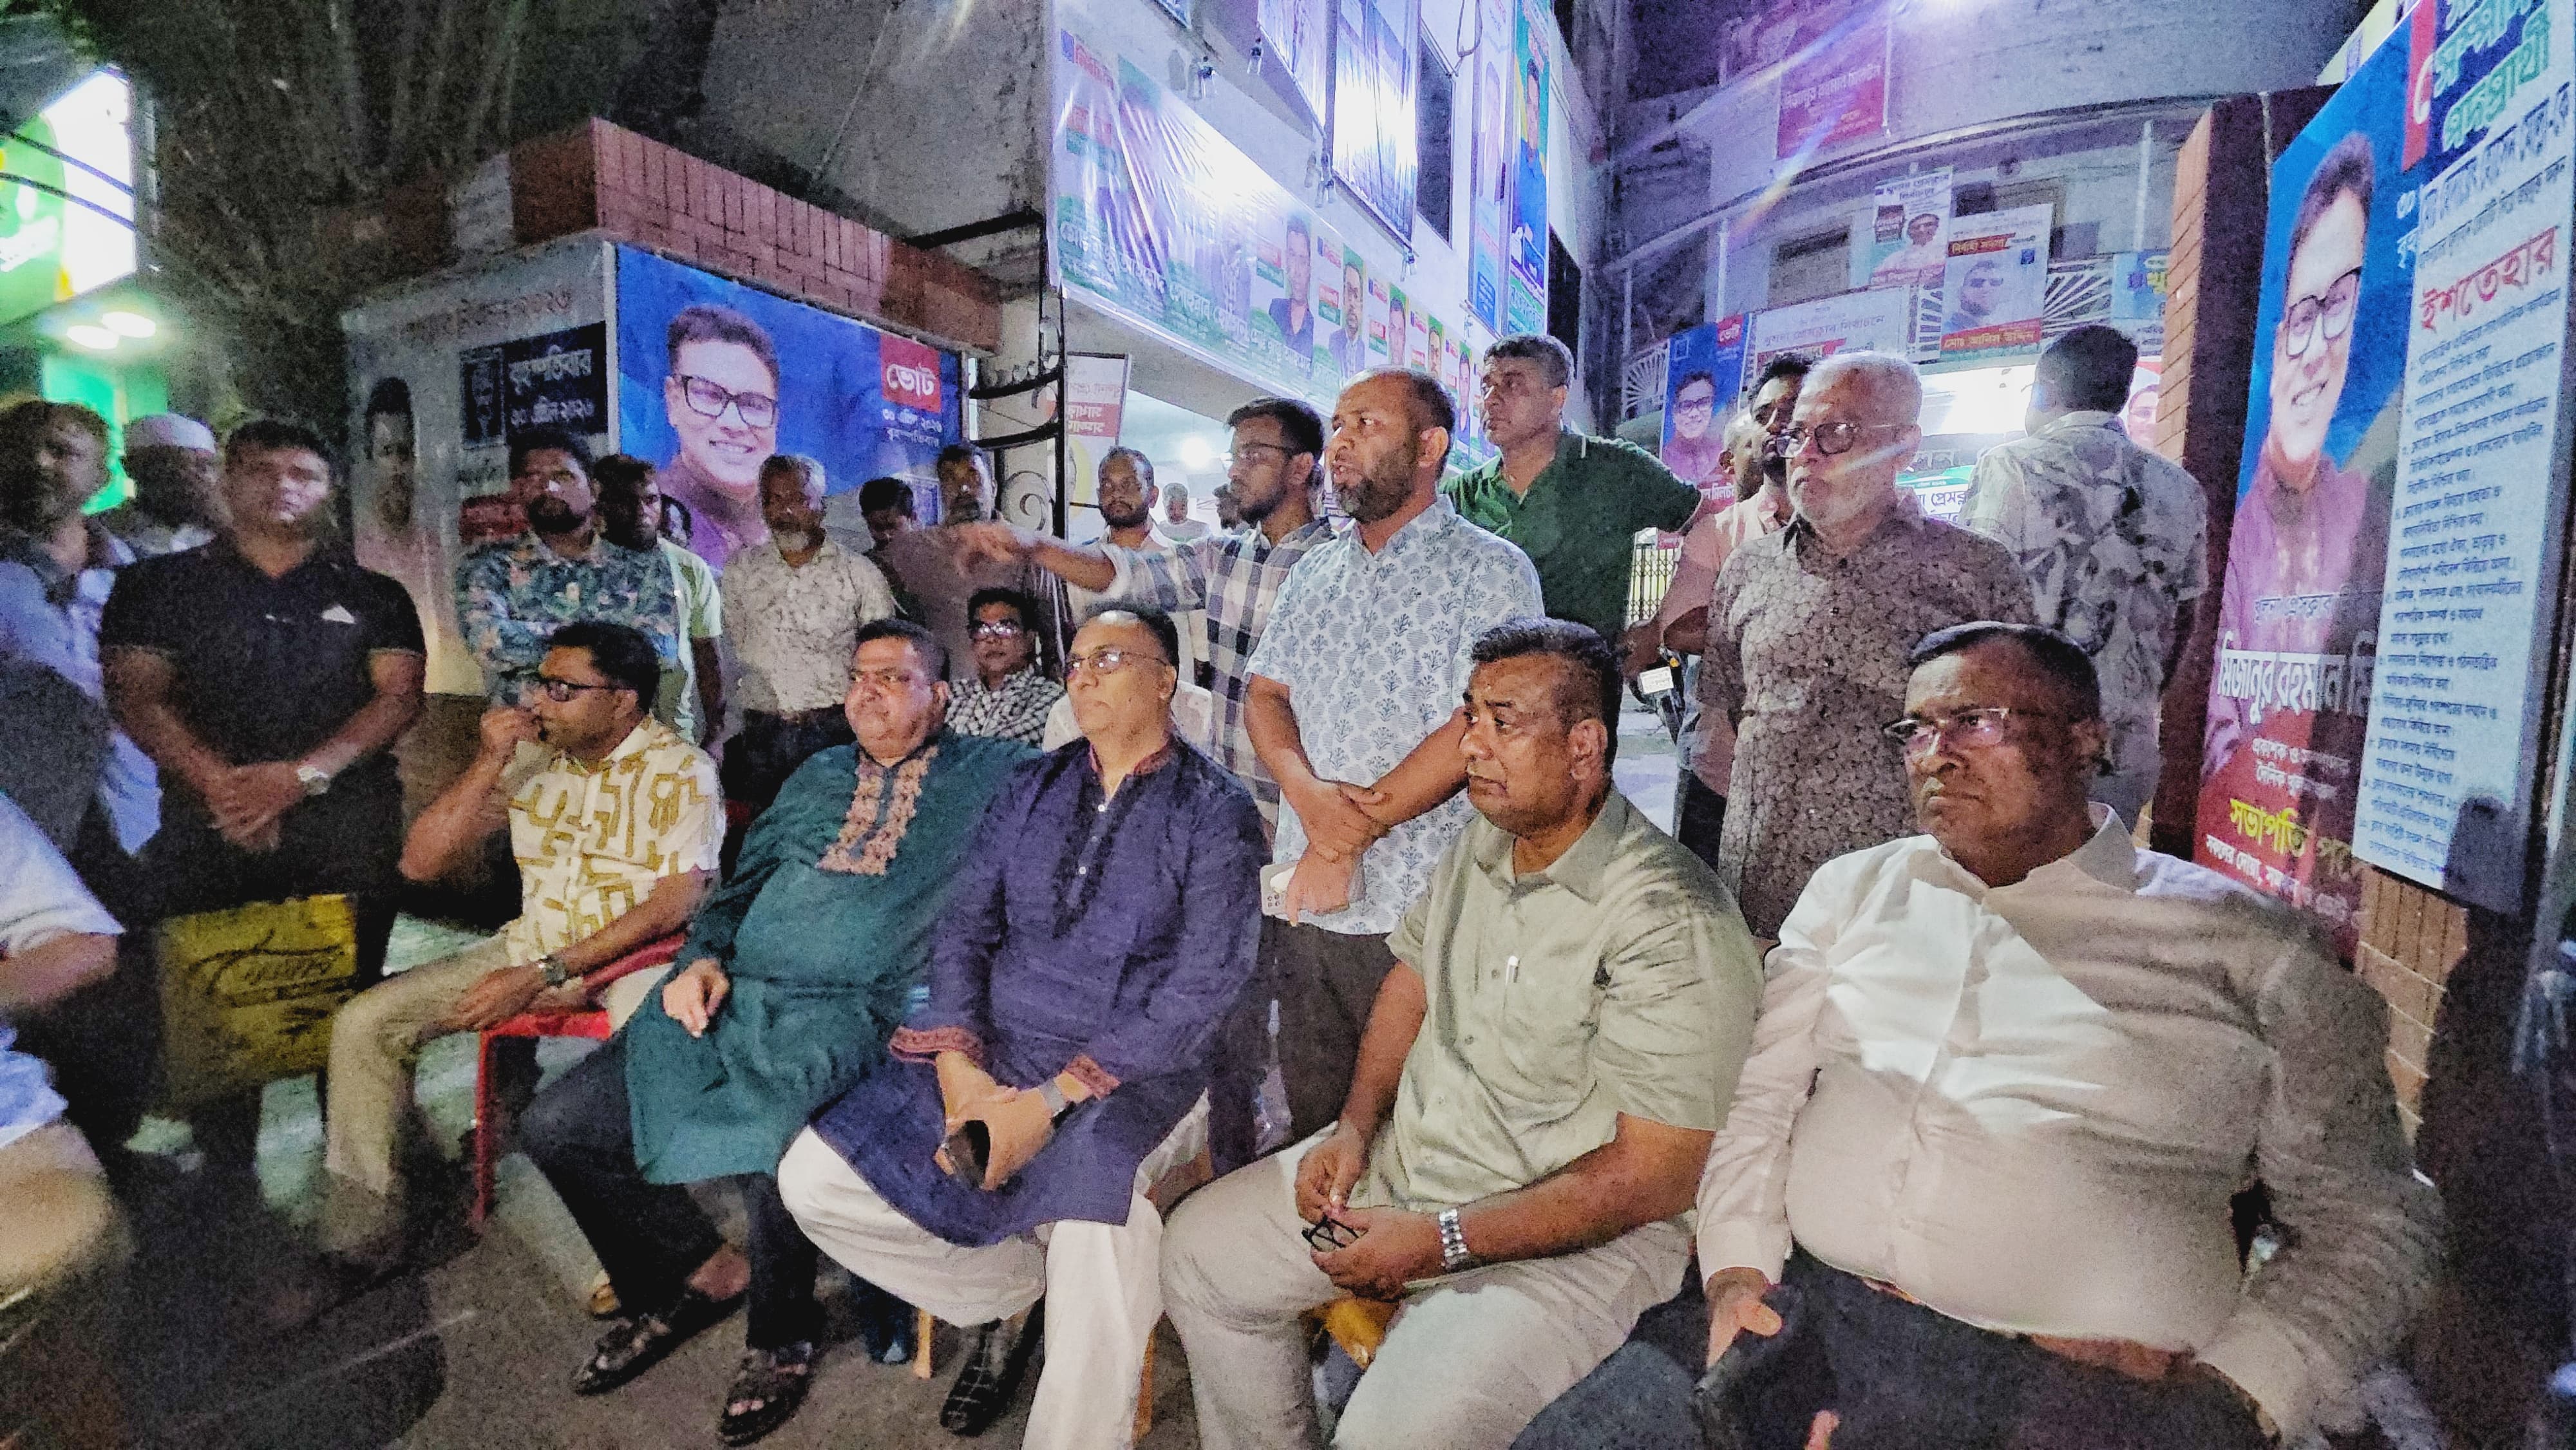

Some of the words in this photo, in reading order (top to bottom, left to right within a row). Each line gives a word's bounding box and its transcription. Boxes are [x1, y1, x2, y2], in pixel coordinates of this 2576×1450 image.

[2420, 225, 2559, 332] ইশতেহার
[886, 362, 937, 398] ভোট
[2217, 630, 2275, 726] মিজানুর
[2277, 650, 2346, 716] রহমান
[2230, 798, 2312, 858] সভাপতি
